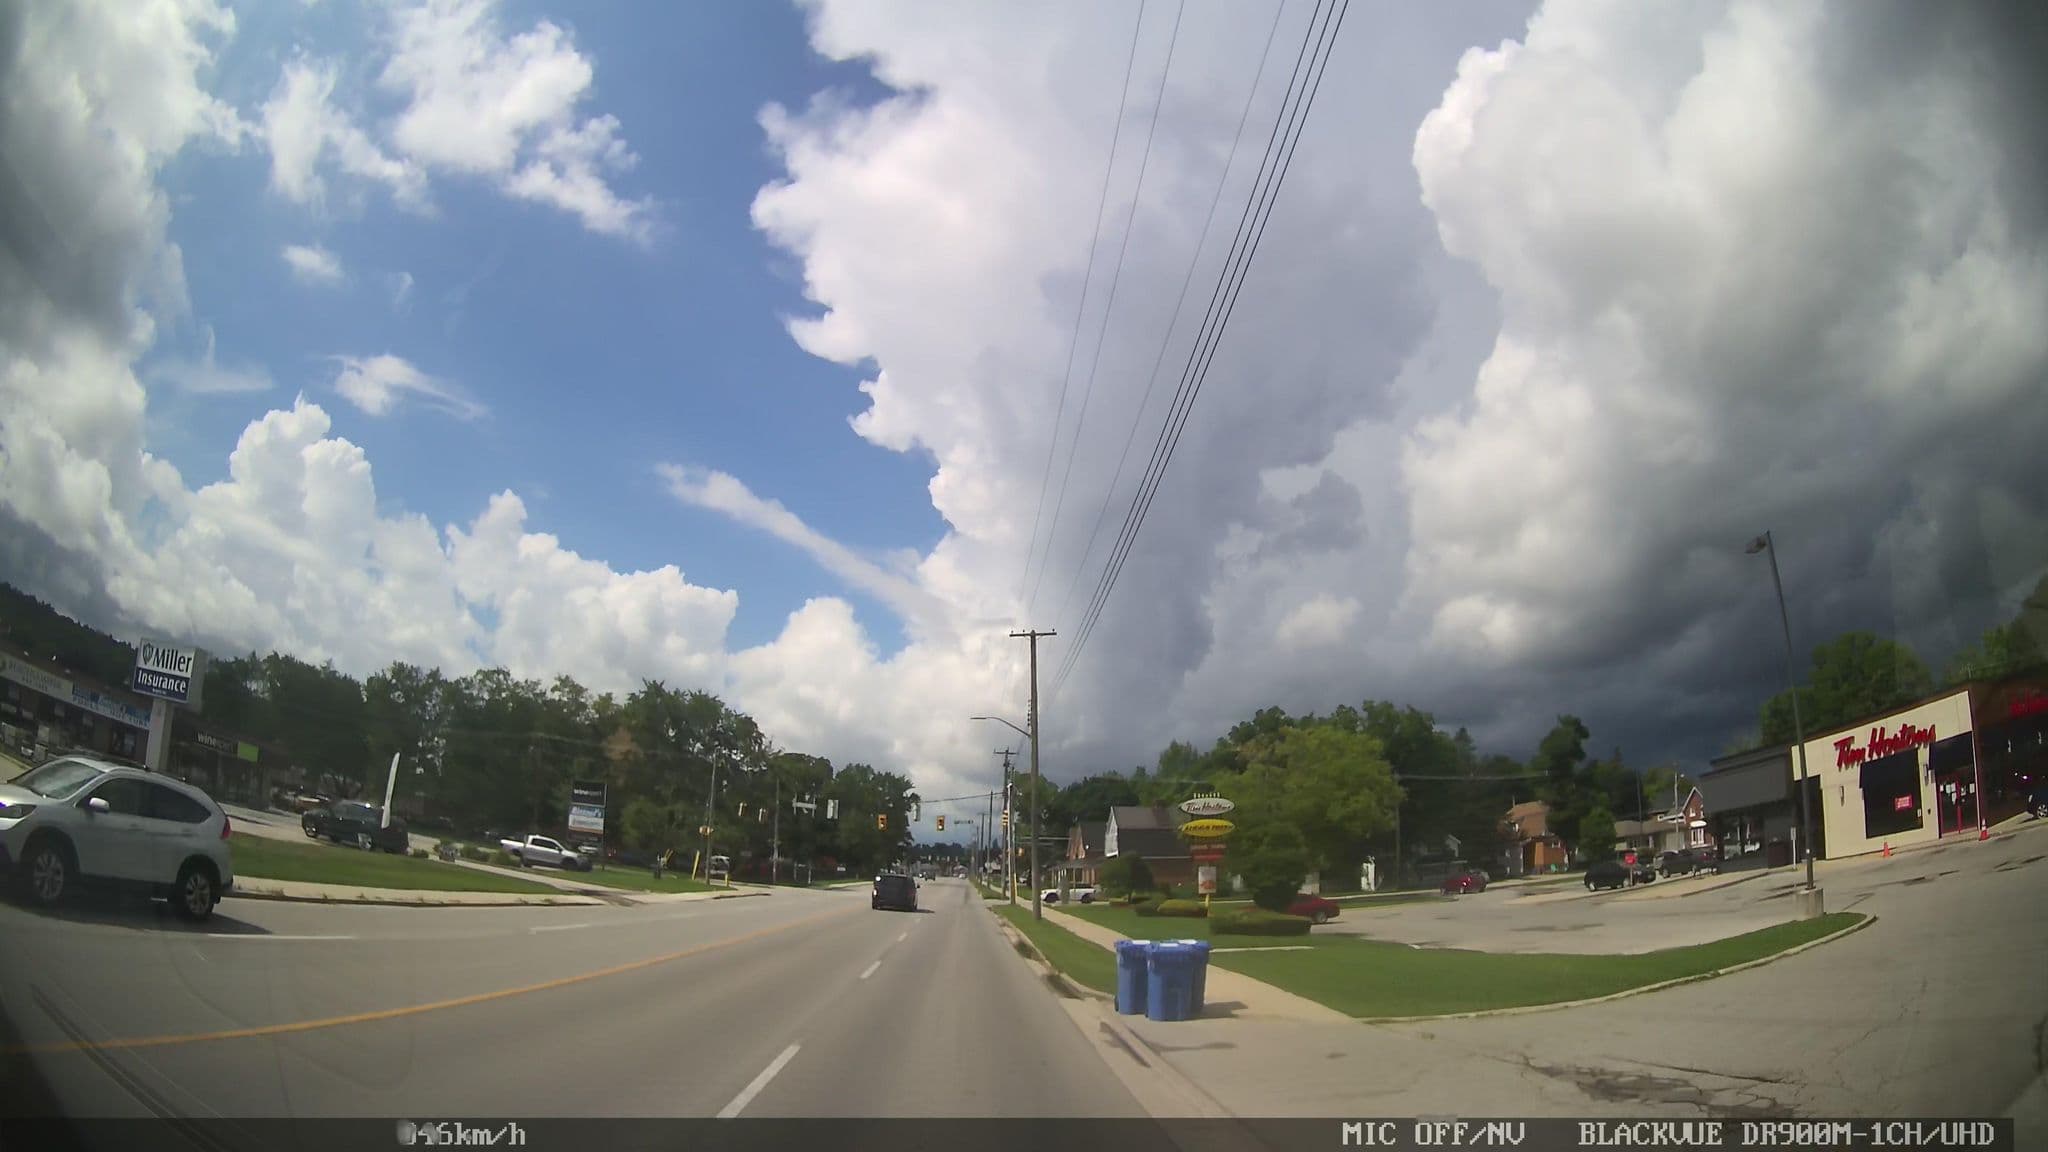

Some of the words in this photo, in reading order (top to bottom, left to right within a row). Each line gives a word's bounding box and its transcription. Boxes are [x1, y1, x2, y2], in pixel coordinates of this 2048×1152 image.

[152, 647, 192, 673] Miller
[138, 669, 186, 693] Insurance
[1834, 735, 1866, 770] Tim
